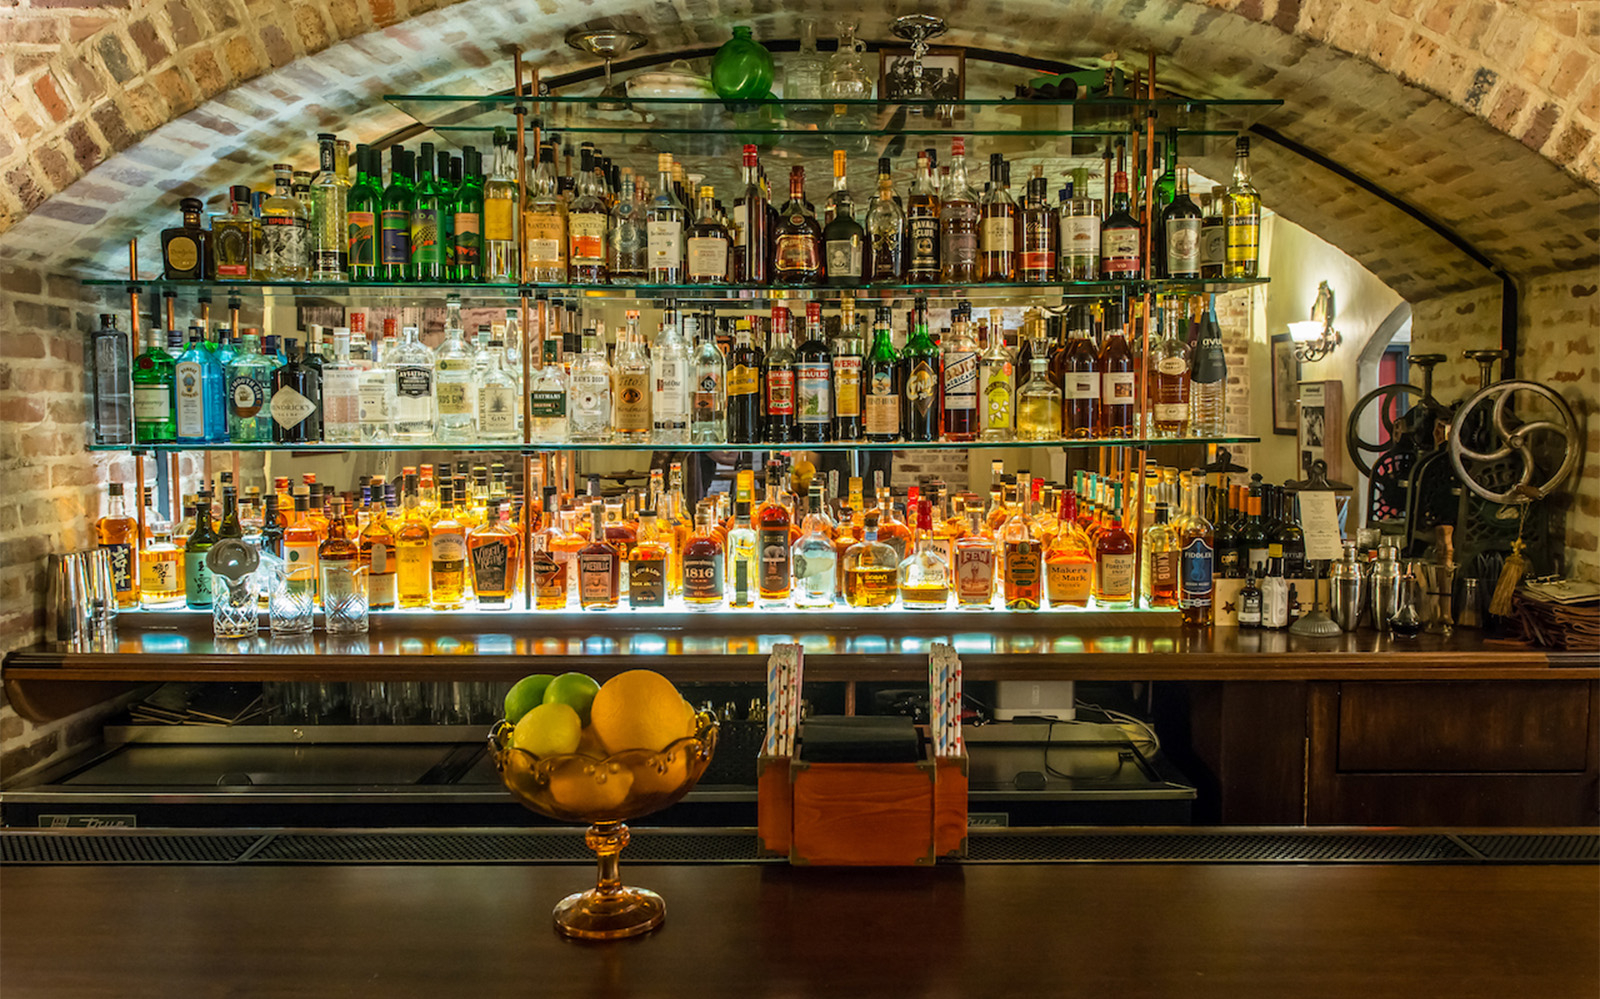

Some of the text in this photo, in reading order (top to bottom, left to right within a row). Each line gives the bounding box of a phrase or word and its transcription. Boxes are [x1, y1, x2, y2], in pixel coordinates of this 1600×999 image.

[916, 229, 934, 238] CLUB
[833, 359, 862, 368] AVERNA
[945, 358, 976, 381] BRUTO
[619, 376, 644, 386] Tito's
[479, 389, 487, 431] BULRUSH
[963, 551, 988, 562] FEW
[1051, 566, 1088, 574] Maker's
[1157, 552, 1171, 580] KNOB
[685, 568, 714, 579] 1816
[1062, 574, 1087, 582] Mark
